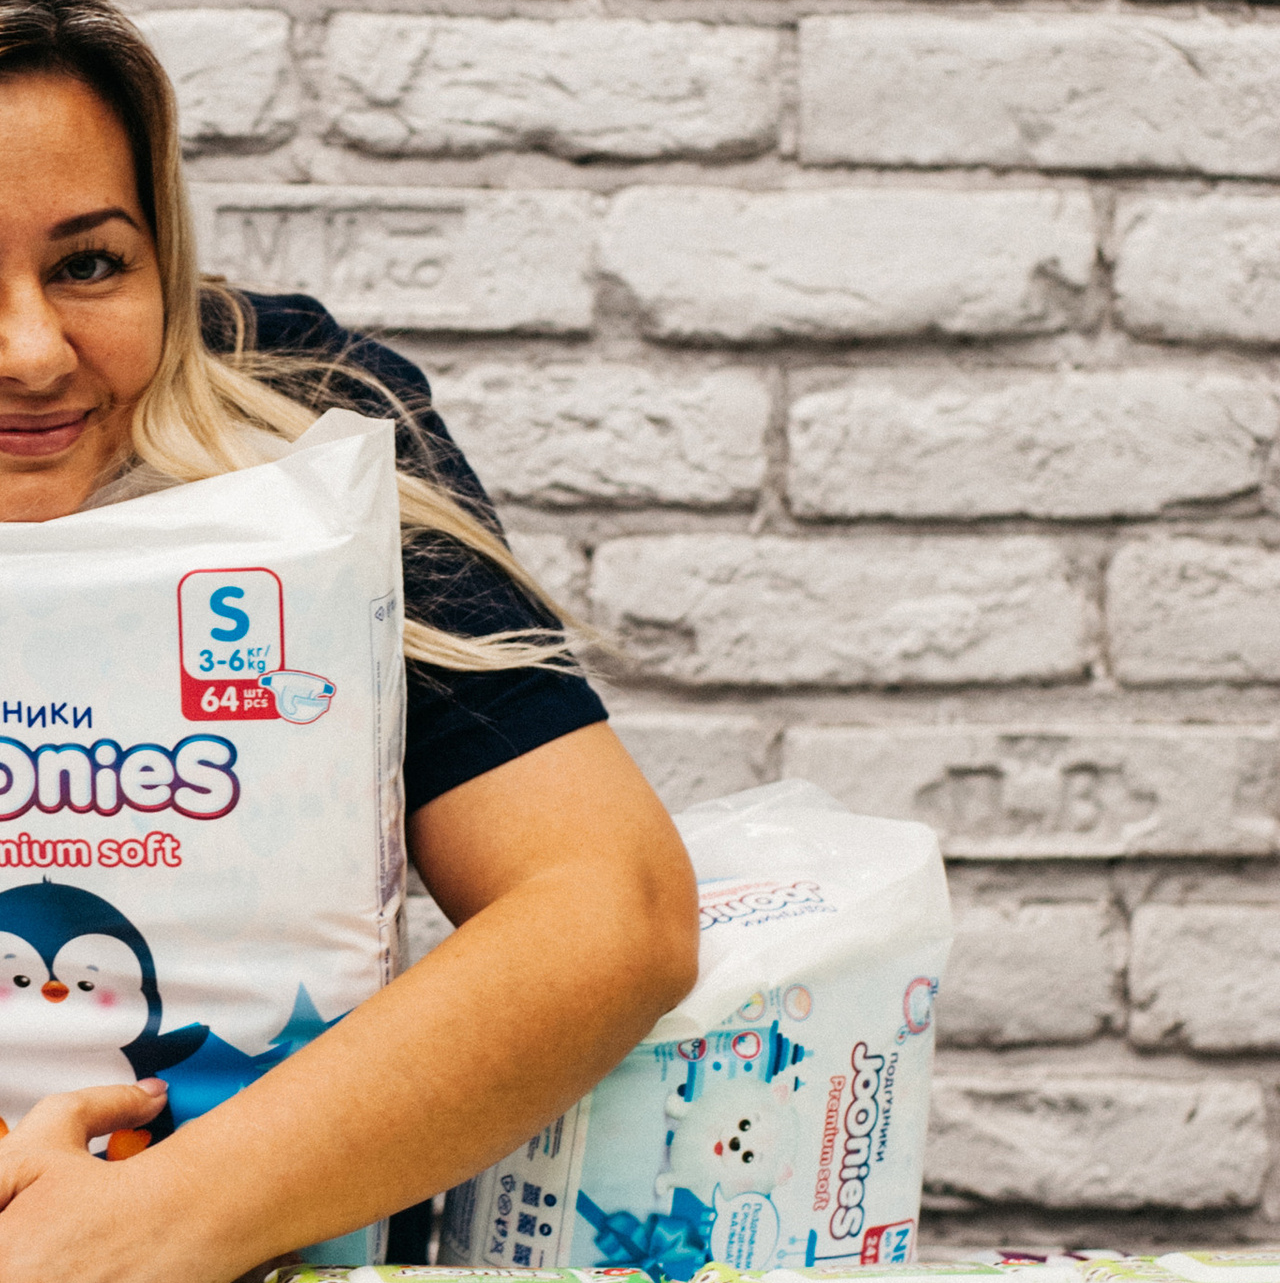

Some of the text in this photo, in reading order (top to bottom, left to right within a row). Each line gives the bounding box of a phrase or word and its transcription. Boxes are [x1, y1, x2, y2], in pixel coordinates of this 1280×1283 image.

[209, 585, 250, 642] S
[199, 649, 245, 672] 3-6
[247, 659, 266, 674] kg
[200, 685, 239, 713] 64
[243, 698, 269, 711] pcs
[96, 829, 183, 869] soft
[812, 1074, 847, 1212] Premium soft
